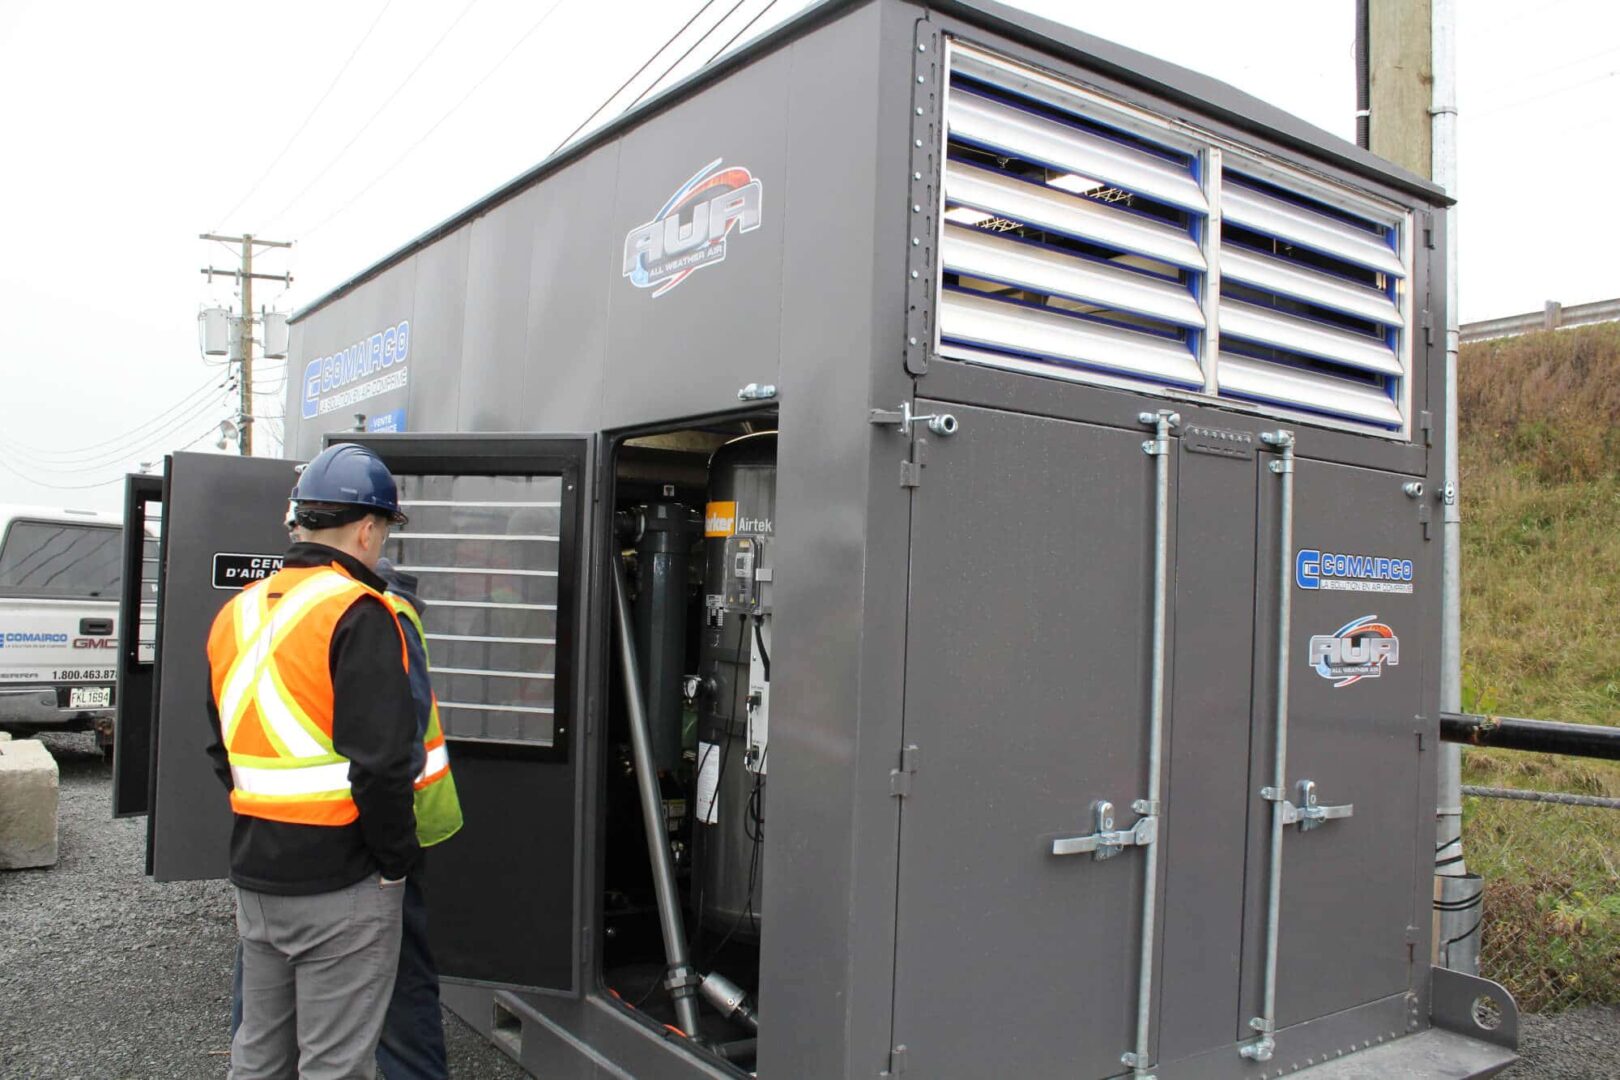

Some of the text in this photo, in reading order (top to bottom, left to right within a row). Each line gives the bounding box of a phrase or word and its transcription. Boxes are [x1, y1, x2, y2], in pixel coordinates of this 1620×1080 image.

[649, 245, 722, 275] ALL WEATHER AIR
[321, 320, 409, 393] COMAIRCO
[738, 516, 772, 533] Airtek
[250, 558, 284, 569] CEN
[1321, 553, 1413, 581] COMAIRCO
[226, 568, 265, 578] D'AIR
[6, 632, 68, 642] COMAIRCO
[72, 638, 119, 649] GMC
